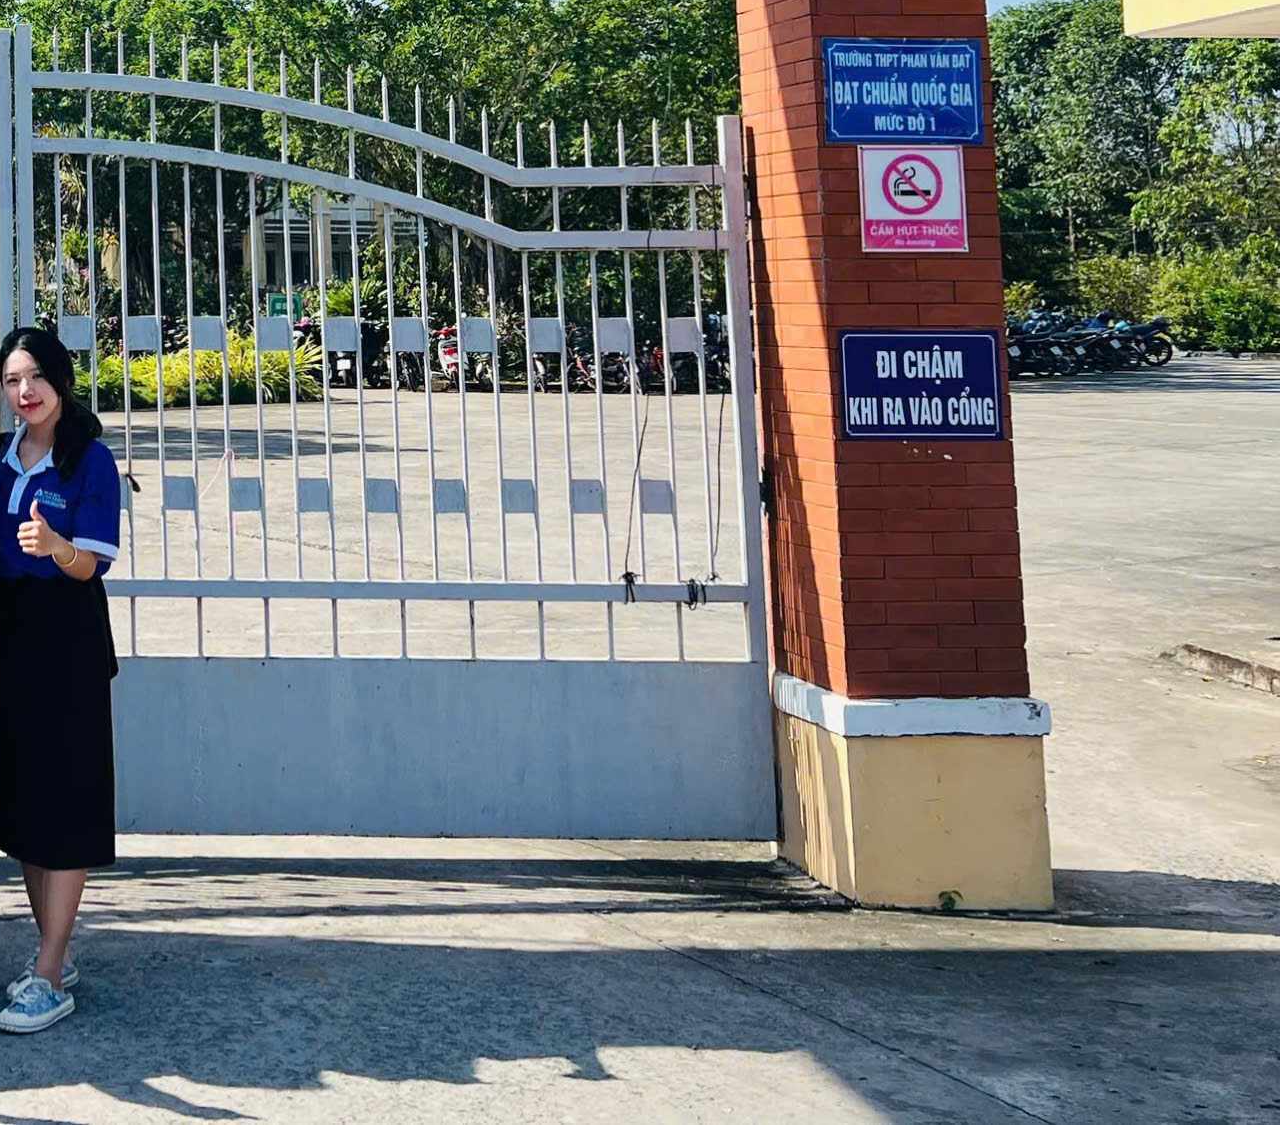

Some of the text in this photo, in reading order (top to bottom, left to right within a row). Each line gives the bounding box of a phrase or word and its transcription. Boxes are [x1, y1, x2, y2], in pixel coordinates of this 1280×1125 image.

[874, 53, 900, 68] THPT
[900, 53, 928, 68] PHAN
[834, 73, 973, 110] ĐẠT CHUẨN QUỐC GIA
[874, 113, 904, 132] MỨC
[930, 117, 936, 132] 1
[876, 345, 964, 385] ĐI CHẬM
[849, 386, 995, 426] KHI RA VÀO CỔNG
